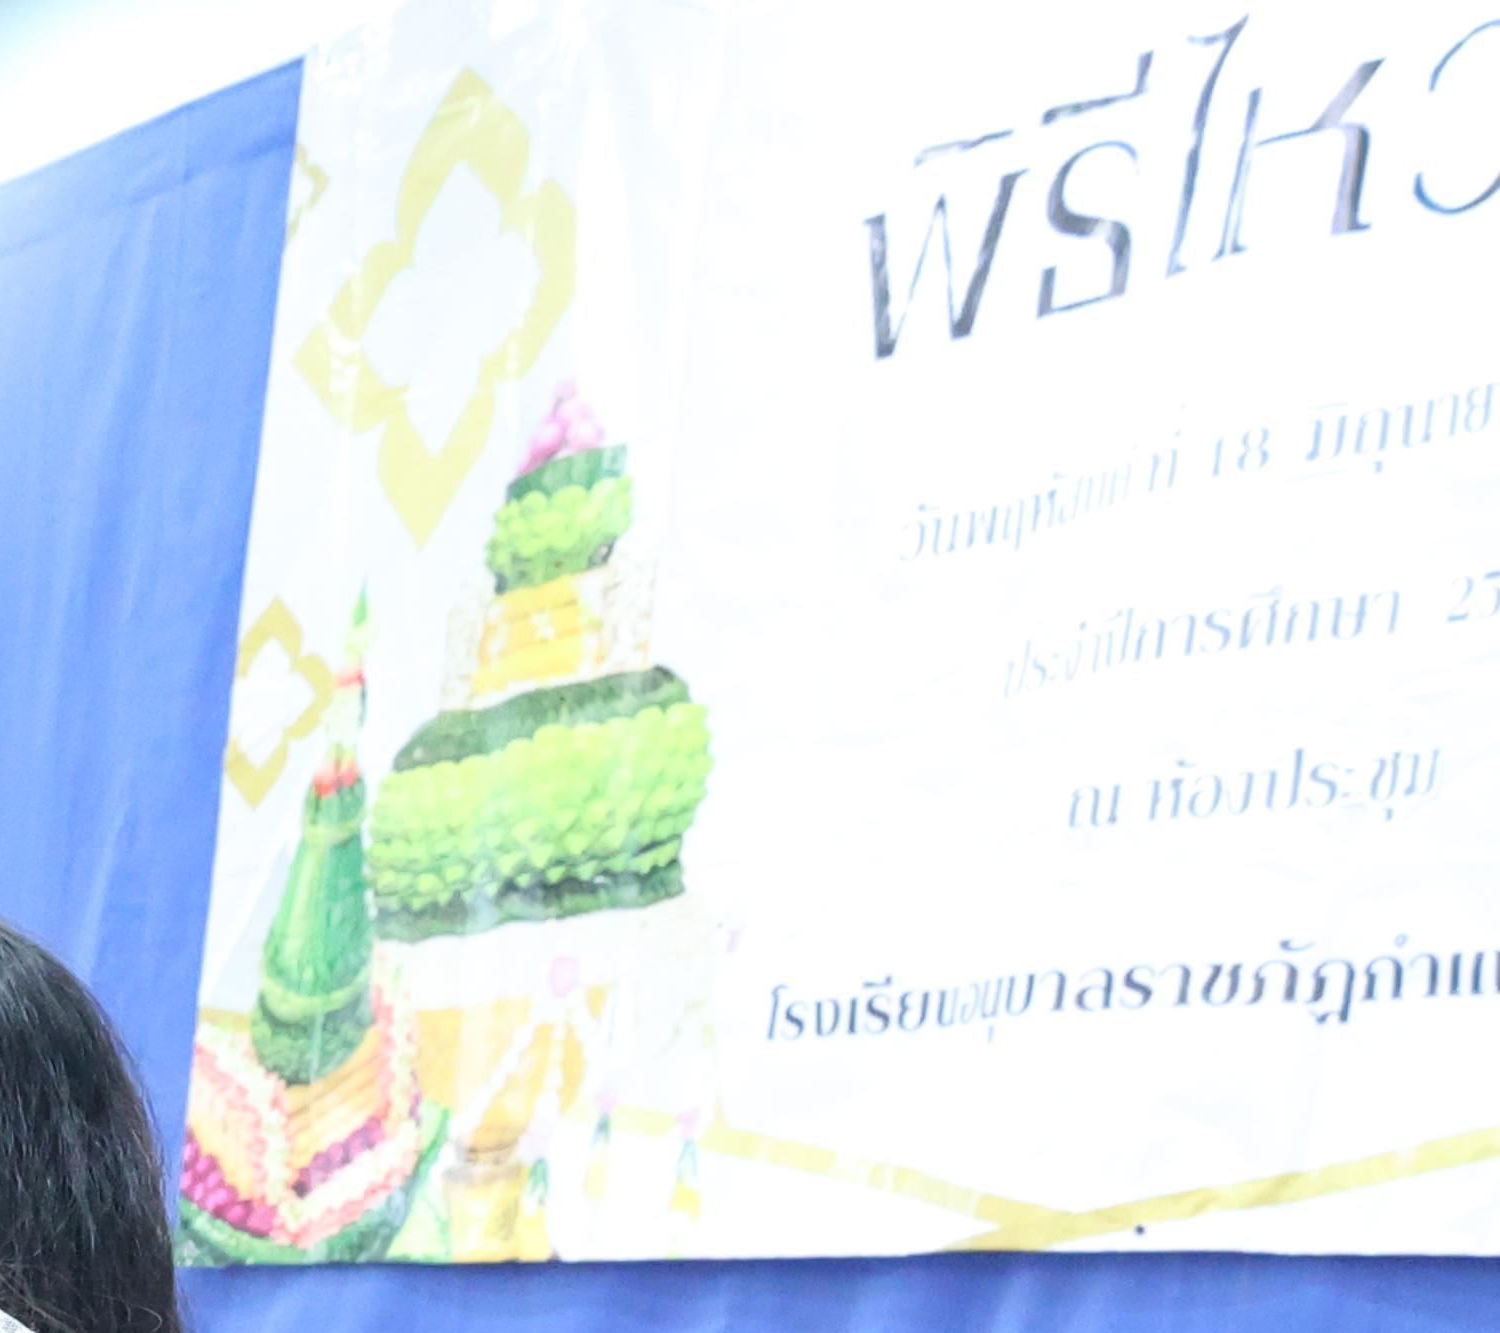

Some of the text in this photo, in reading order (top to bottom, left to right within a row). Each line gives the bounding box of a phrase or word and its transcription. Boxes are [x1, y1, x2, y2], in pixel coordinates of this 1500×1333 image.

[1211, 424, 1273, 479] 18
[1304, 380, 1500, 476] มิถุนาย
[764, 931, 1500, 1046] โรงเรียนอนุบาลราชภัฏกำแ
